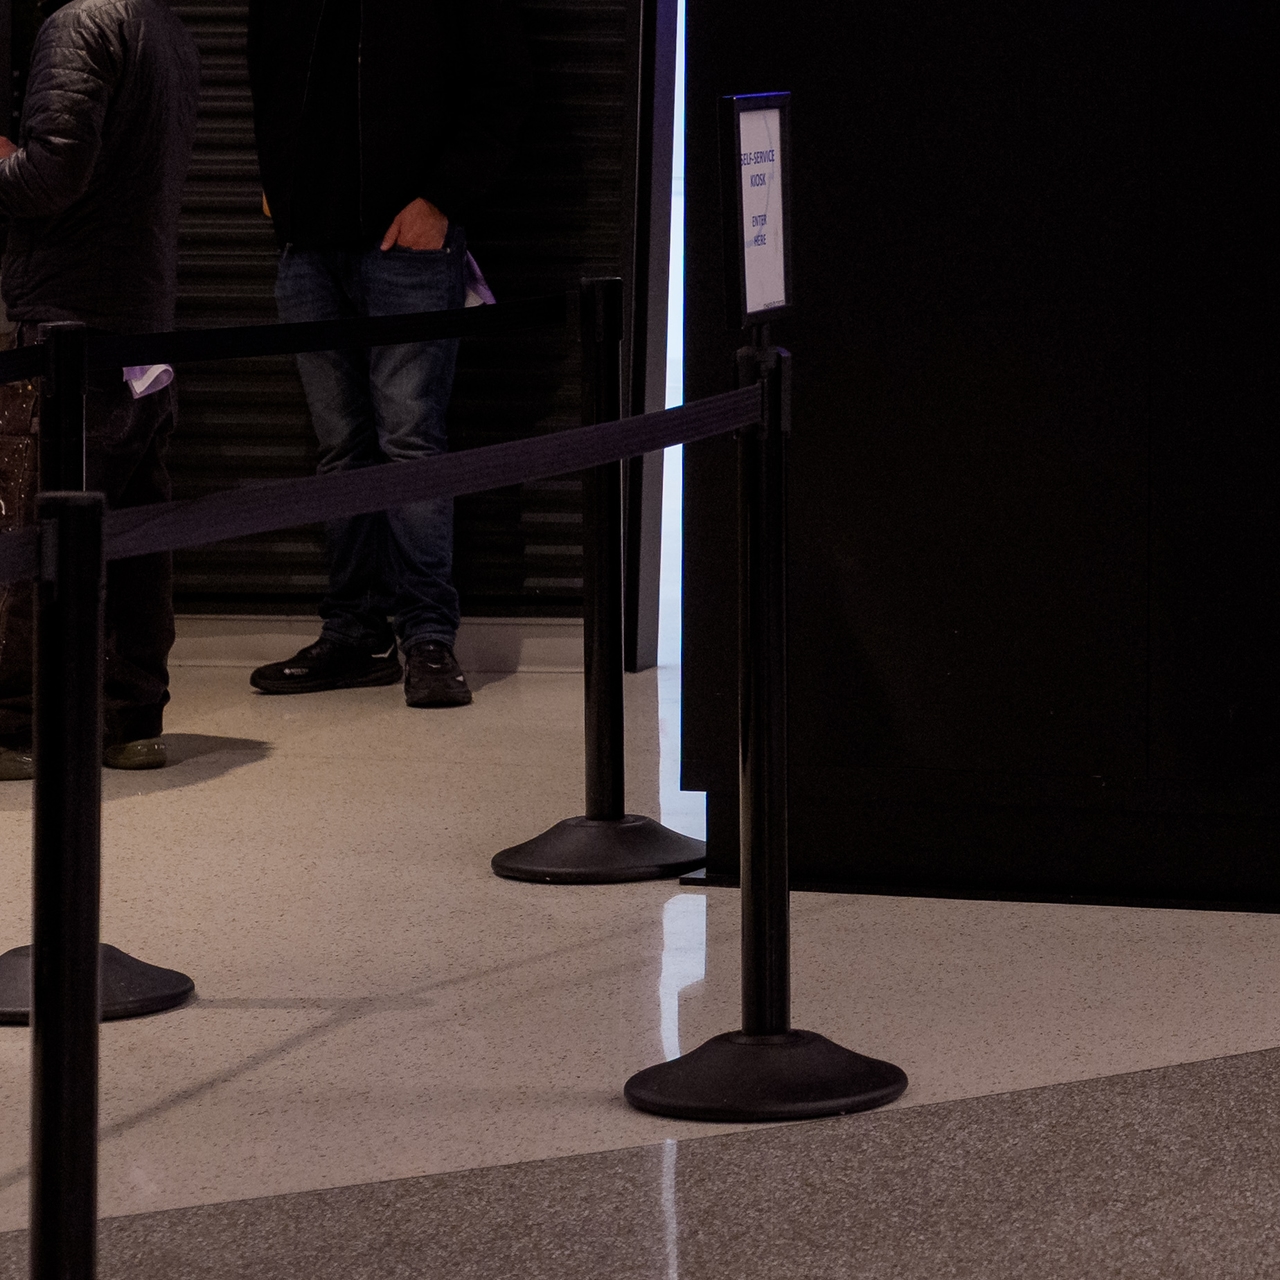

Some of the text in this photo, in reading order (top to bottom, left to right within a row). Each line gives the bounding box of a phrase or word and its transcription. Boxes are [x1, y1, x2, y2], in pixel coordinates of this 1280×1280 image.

[741, 149, 775, 166] SELF-SERVICE
[750, 173, 766, 187] KIOSK
[752, 214, 767, 227] ENTER
[753, 234, 767, 246] HERE
